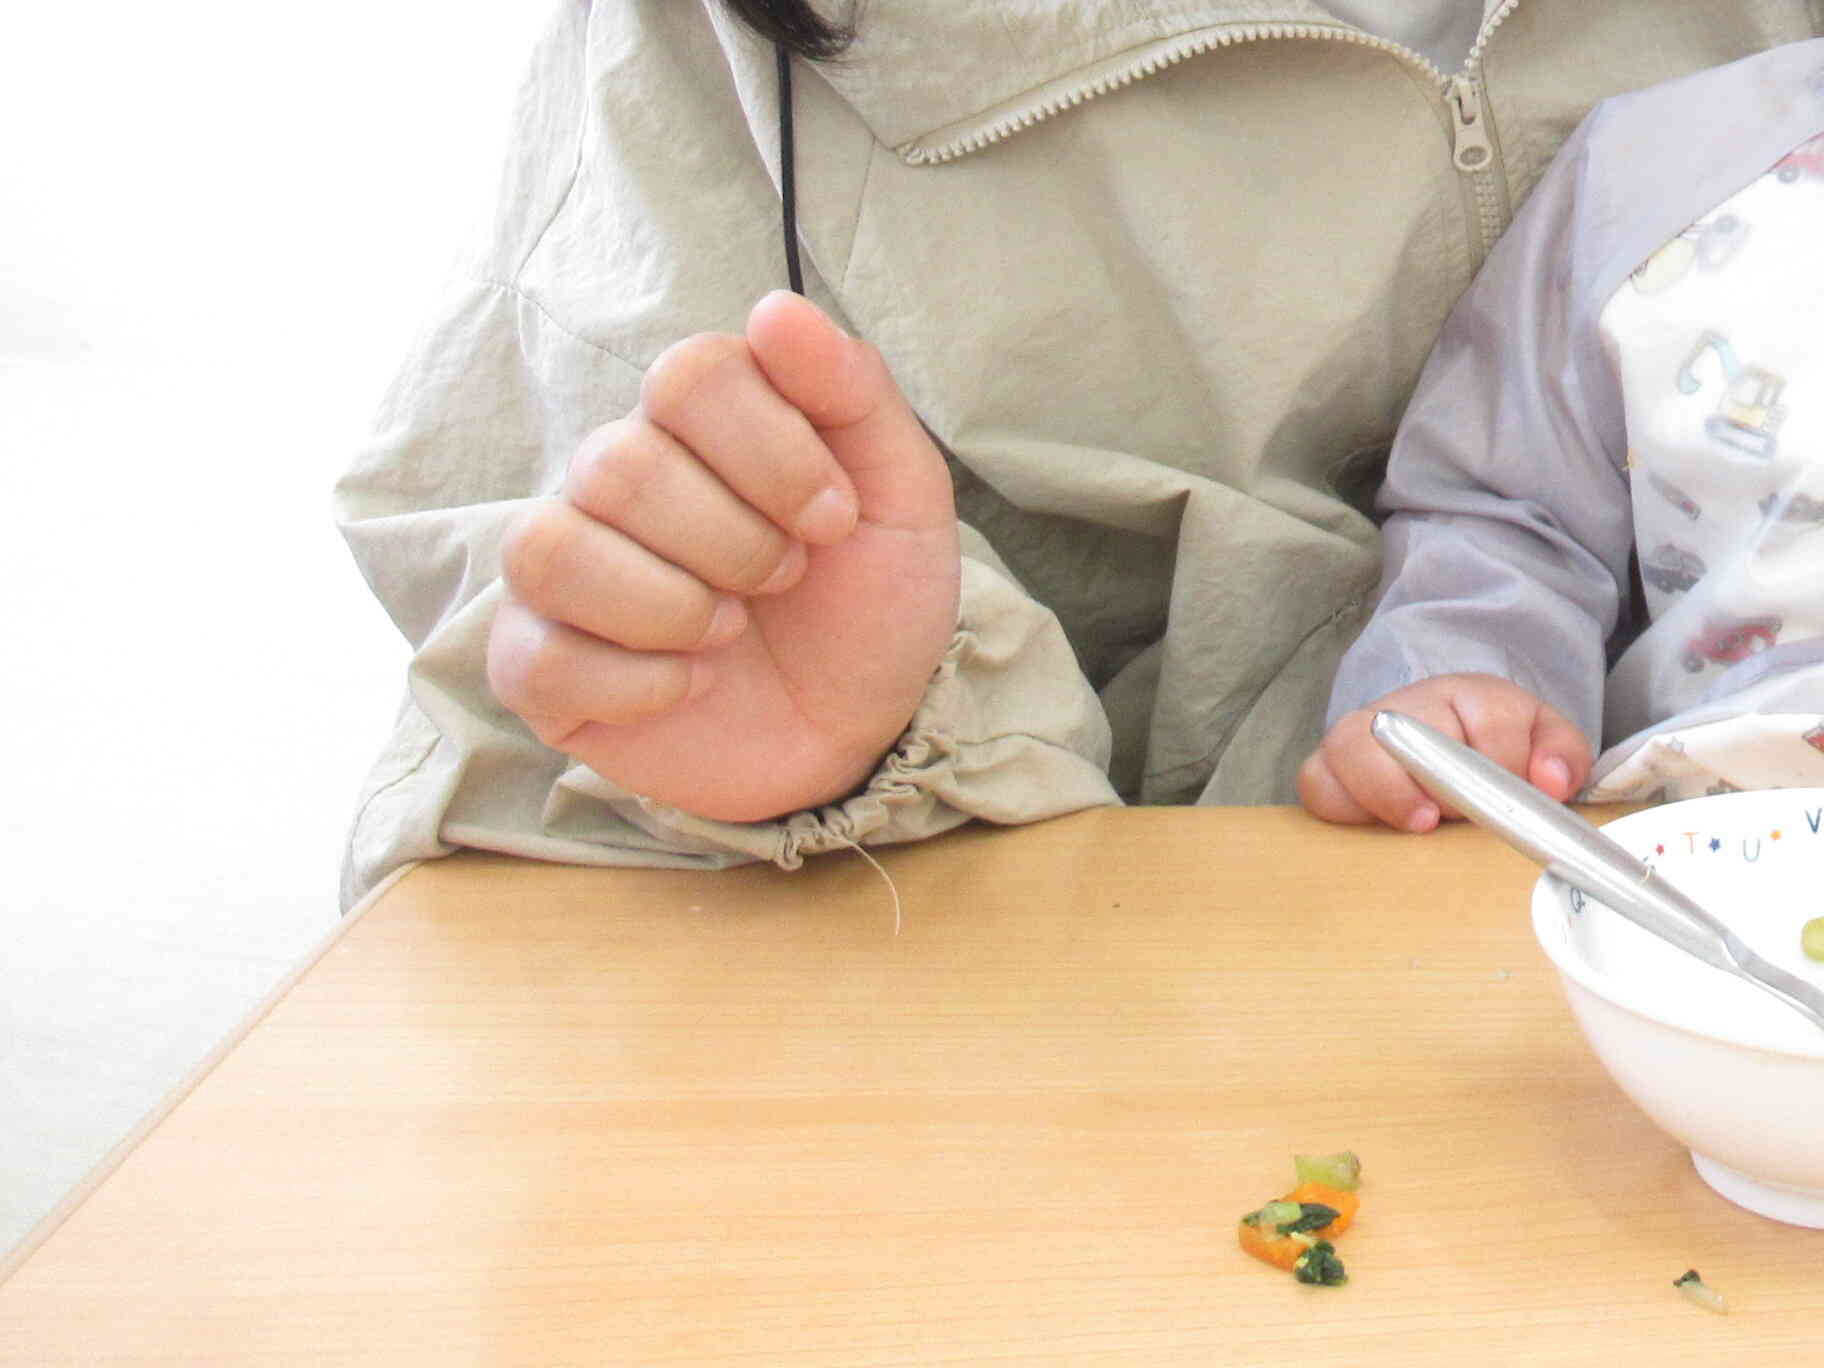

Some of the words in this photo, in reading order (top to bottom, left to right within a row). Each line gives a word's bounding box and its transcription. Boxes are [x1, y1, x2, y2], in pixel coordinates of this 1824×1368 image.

[1681, 832, 1699, 855] T
[1742, 836, 1761, 863] U
[1804, 806, 1823, 834] V
